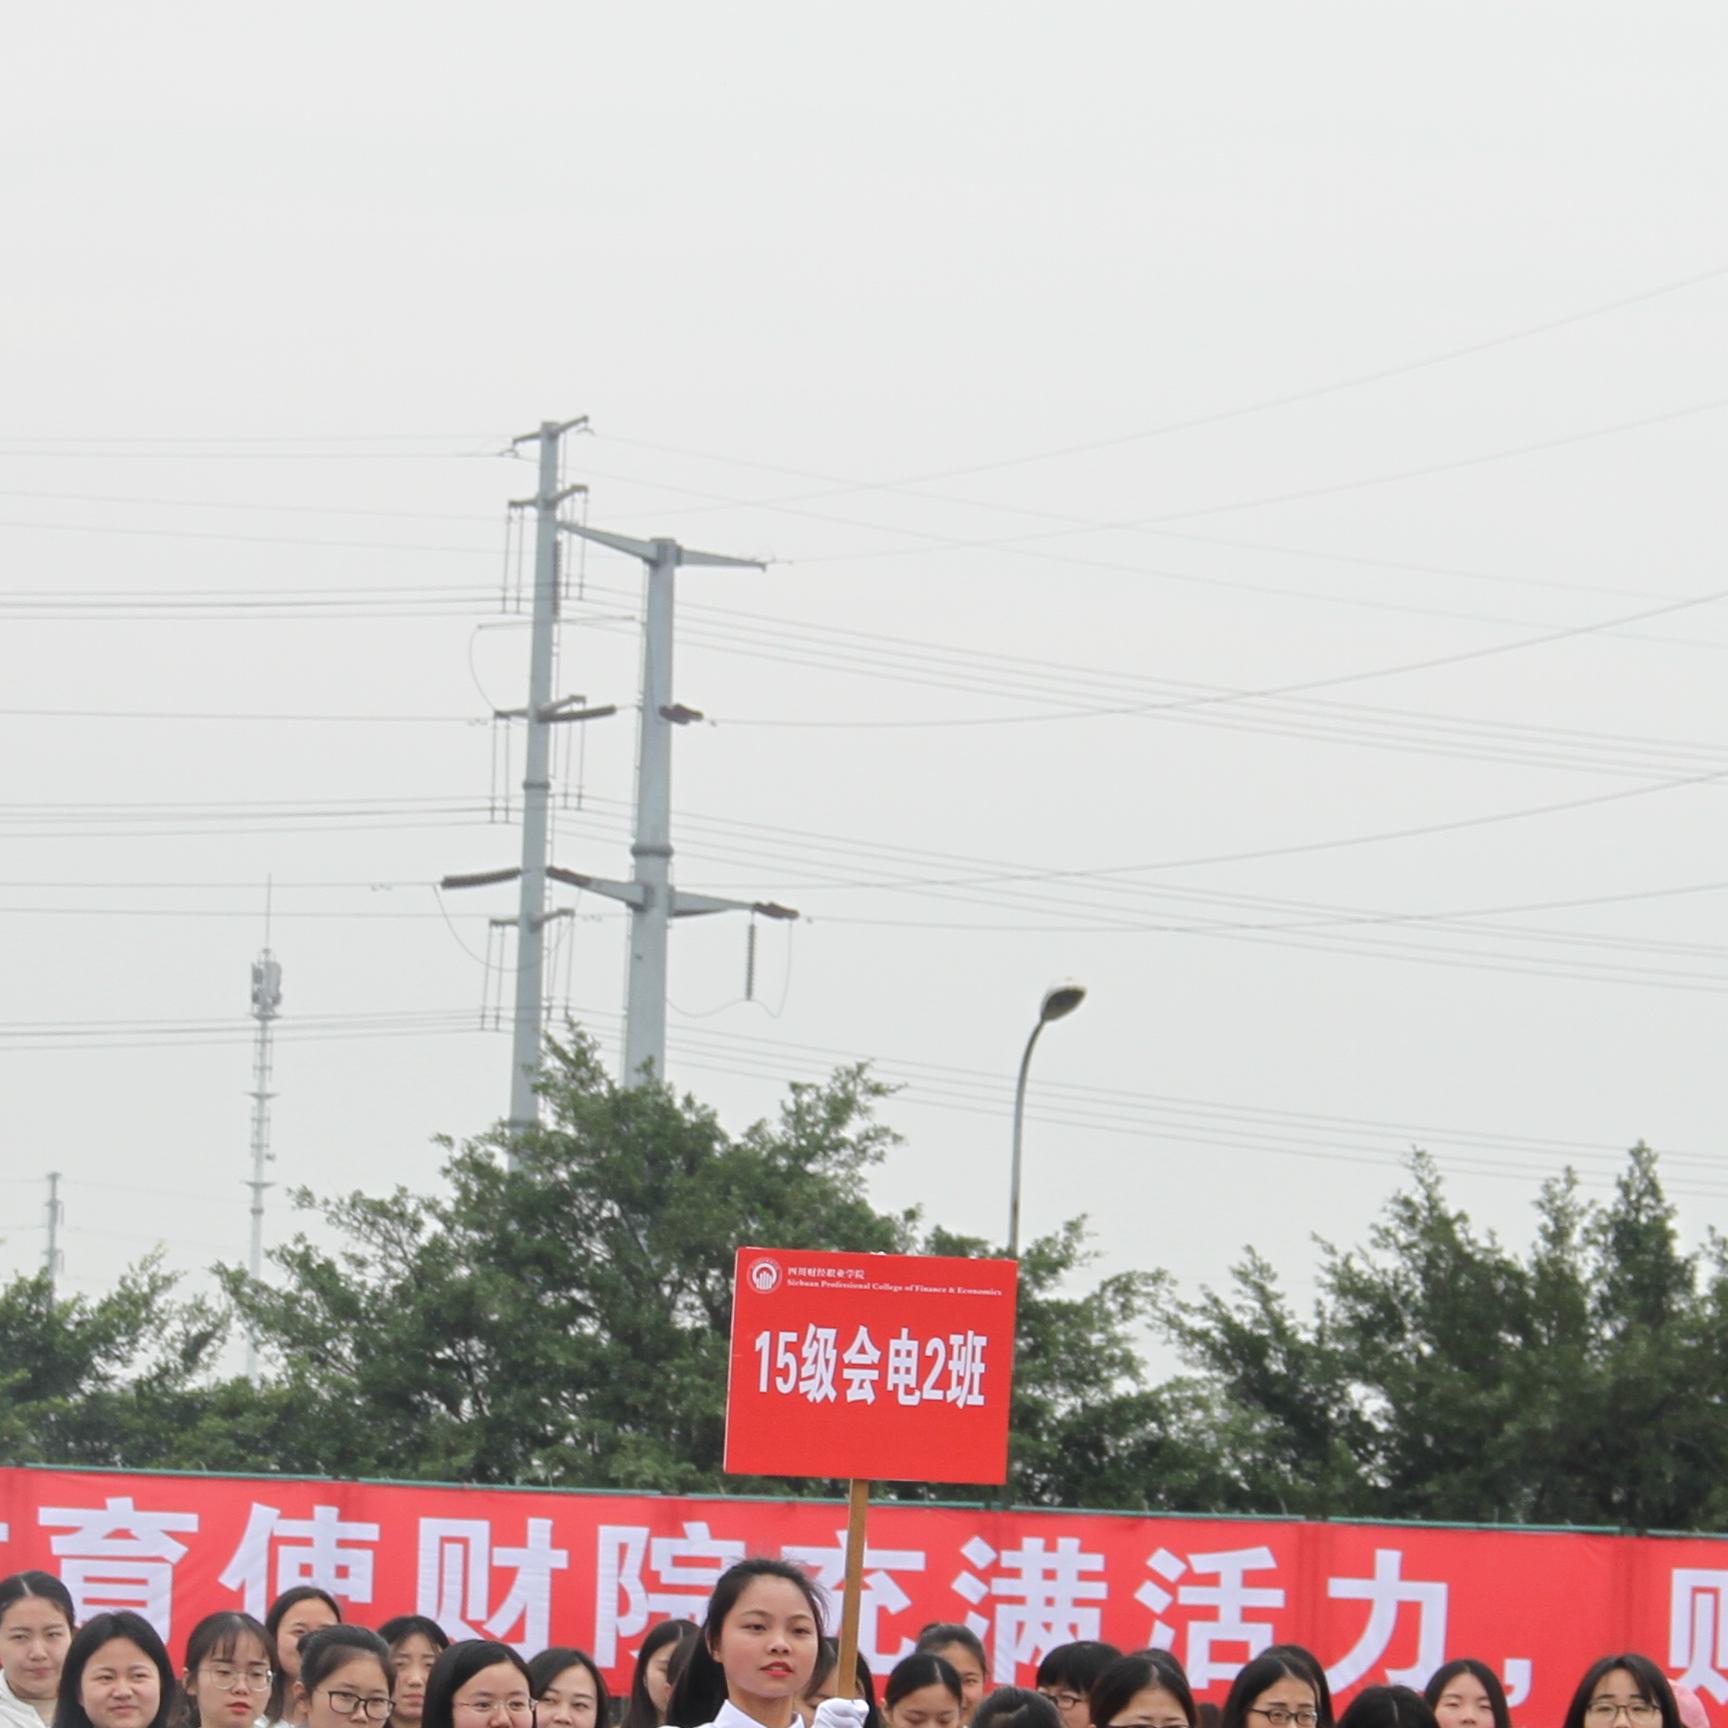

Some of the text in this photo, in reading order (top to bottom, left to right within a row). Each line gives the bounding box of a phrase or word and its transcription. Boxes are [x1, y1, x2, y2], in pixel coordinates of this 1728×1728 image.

[786, 1279, 820, 1288] Sichuan
[820, 1280, 871, 1290] Professional
[872, 1282, 903, 1292] College
[904, 1283, 913, 1292] of
[914, 1284, 947, 1293] Finance
[957, 1286, 1003, 1296] Economics
[754, 1323, 988, 1408] 15级会电2班
